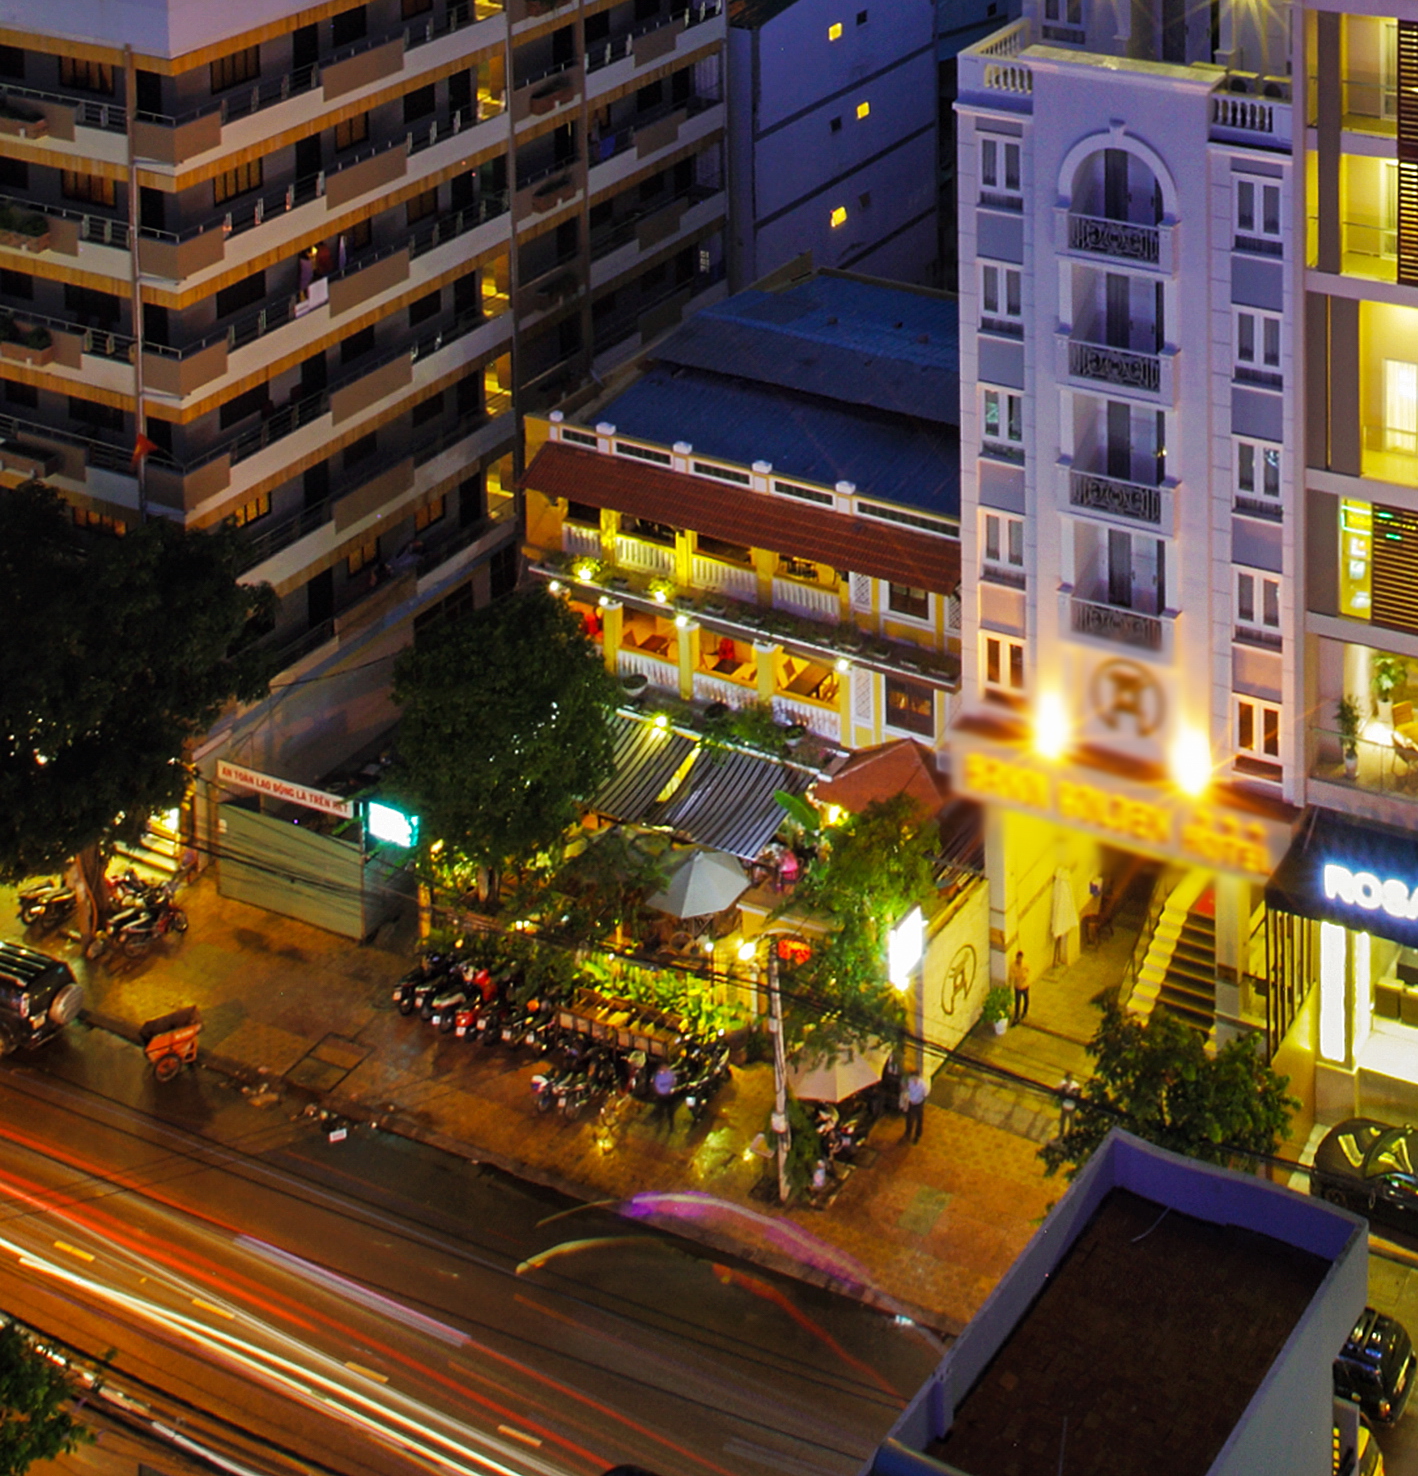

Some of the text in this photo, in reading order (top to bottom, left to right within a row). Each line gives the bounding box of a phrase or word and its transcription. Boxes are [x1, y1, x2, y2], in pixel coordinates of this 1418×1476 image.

[222, 766, 232, 778] AN
[256, 778, 271, 790] LAO
[309, 793, 330, 808] TRÊN
